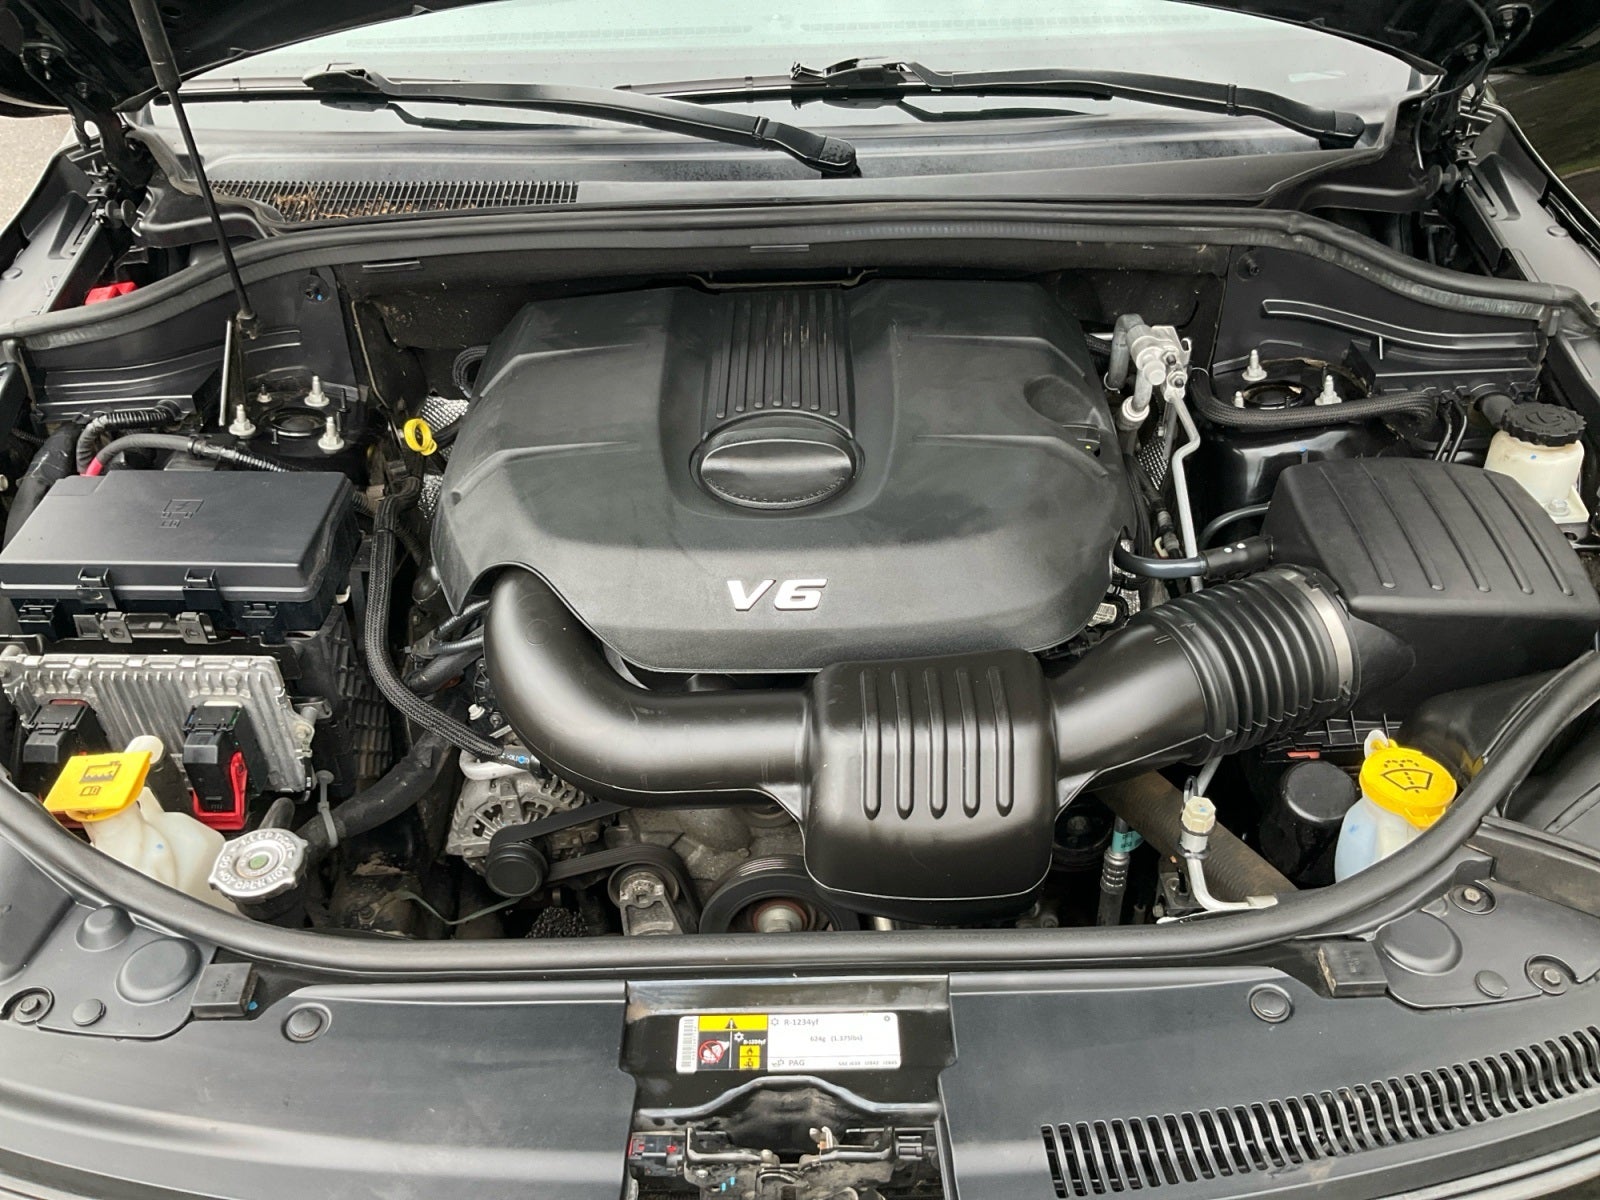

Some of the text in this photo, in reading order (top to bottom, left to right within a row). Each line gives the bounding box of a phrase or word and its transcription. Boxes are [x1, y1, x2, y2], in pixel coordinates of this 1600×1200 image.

[727, 579, 828, 611] V6
[784, 1018, 819, 1026] R-1234yf
[788, 1059, 805, 1067] PAG
